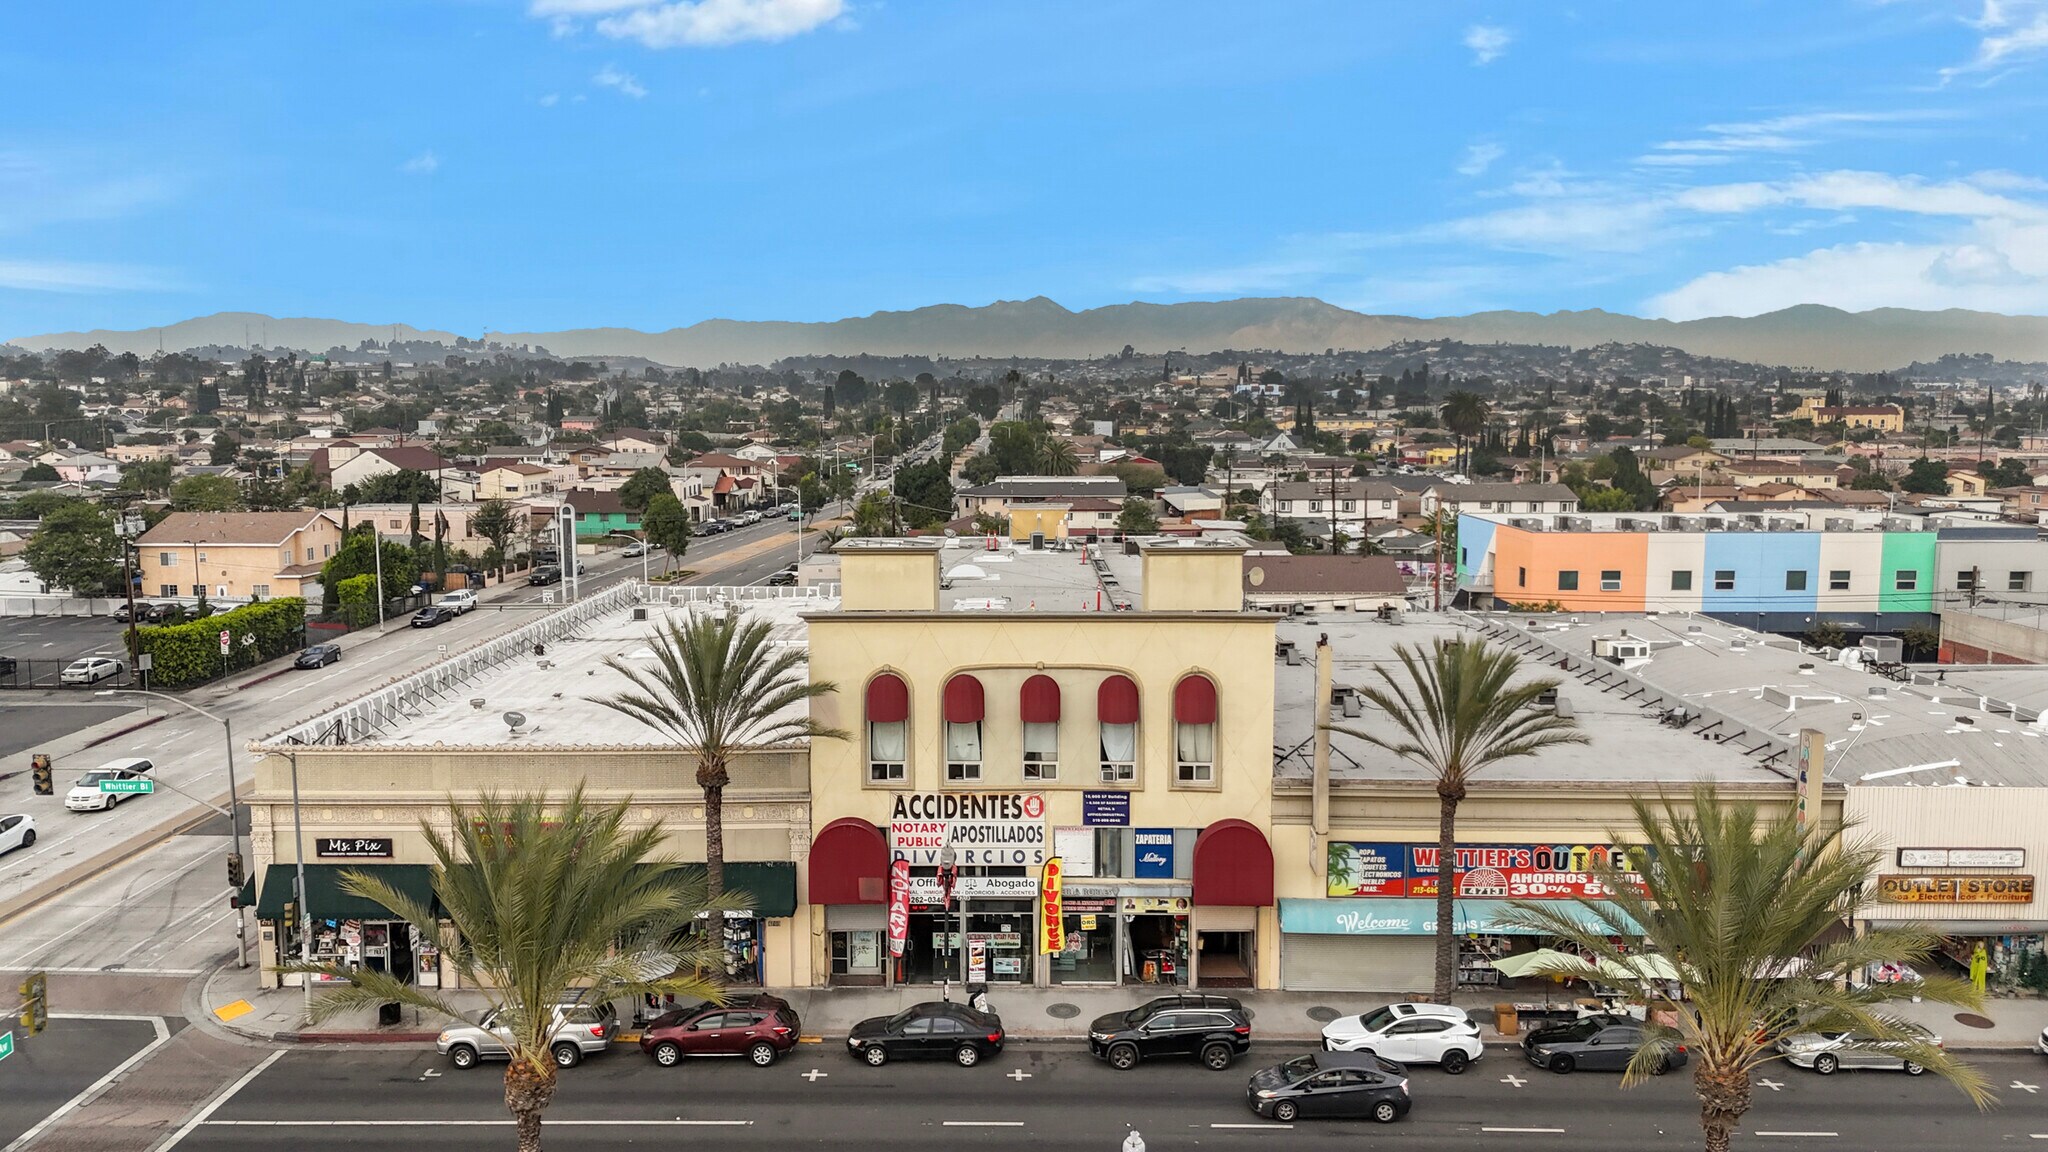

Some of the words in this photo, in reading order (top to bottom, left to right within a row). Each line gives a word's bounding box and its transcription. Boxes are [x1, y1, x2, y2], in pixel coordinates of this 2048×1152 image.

[105, 782, 136, 791] Whittier
[140, 782, 149, 791] Bl
[892, 794, 1023, 820] ACCIDENTES
[892, 823, 947, 833] NOTARY
[951, 825, 1043, 844] APOSTILLADOS
[1136, 834, 1172, 845] ZAPATERIA
[329, 839, 351, 852] Ms.
[355, 839, 382, 852] Pix
[897, 836, 942, 847] PUBLIC
[894, 850, 1043, 864] DIVRCIOS
[1413, 847, 1531, 869] WTTIER'S
[1536, 850, 1640, 871] OUTE
[986, 878, 1036, 889] Abogado
[1510, 873, 1588, 884] AHORROS
[1510, 883, 1572, 895] 30%
[1884, 879, 1961, 893] OUTLET
[1967, 880, 2033, 893] STORE
[889, 866, 908, 937] NOTARY
[1918, 893, 1977, 901] Electroncos
[1987, 893, 2030, 901] Furniture
[1043, 864, 1061, 950] DIVORCE
[1337, 911, 1413, 933] Welcome
[1423, 920, 1478, 932] GRCIAS
